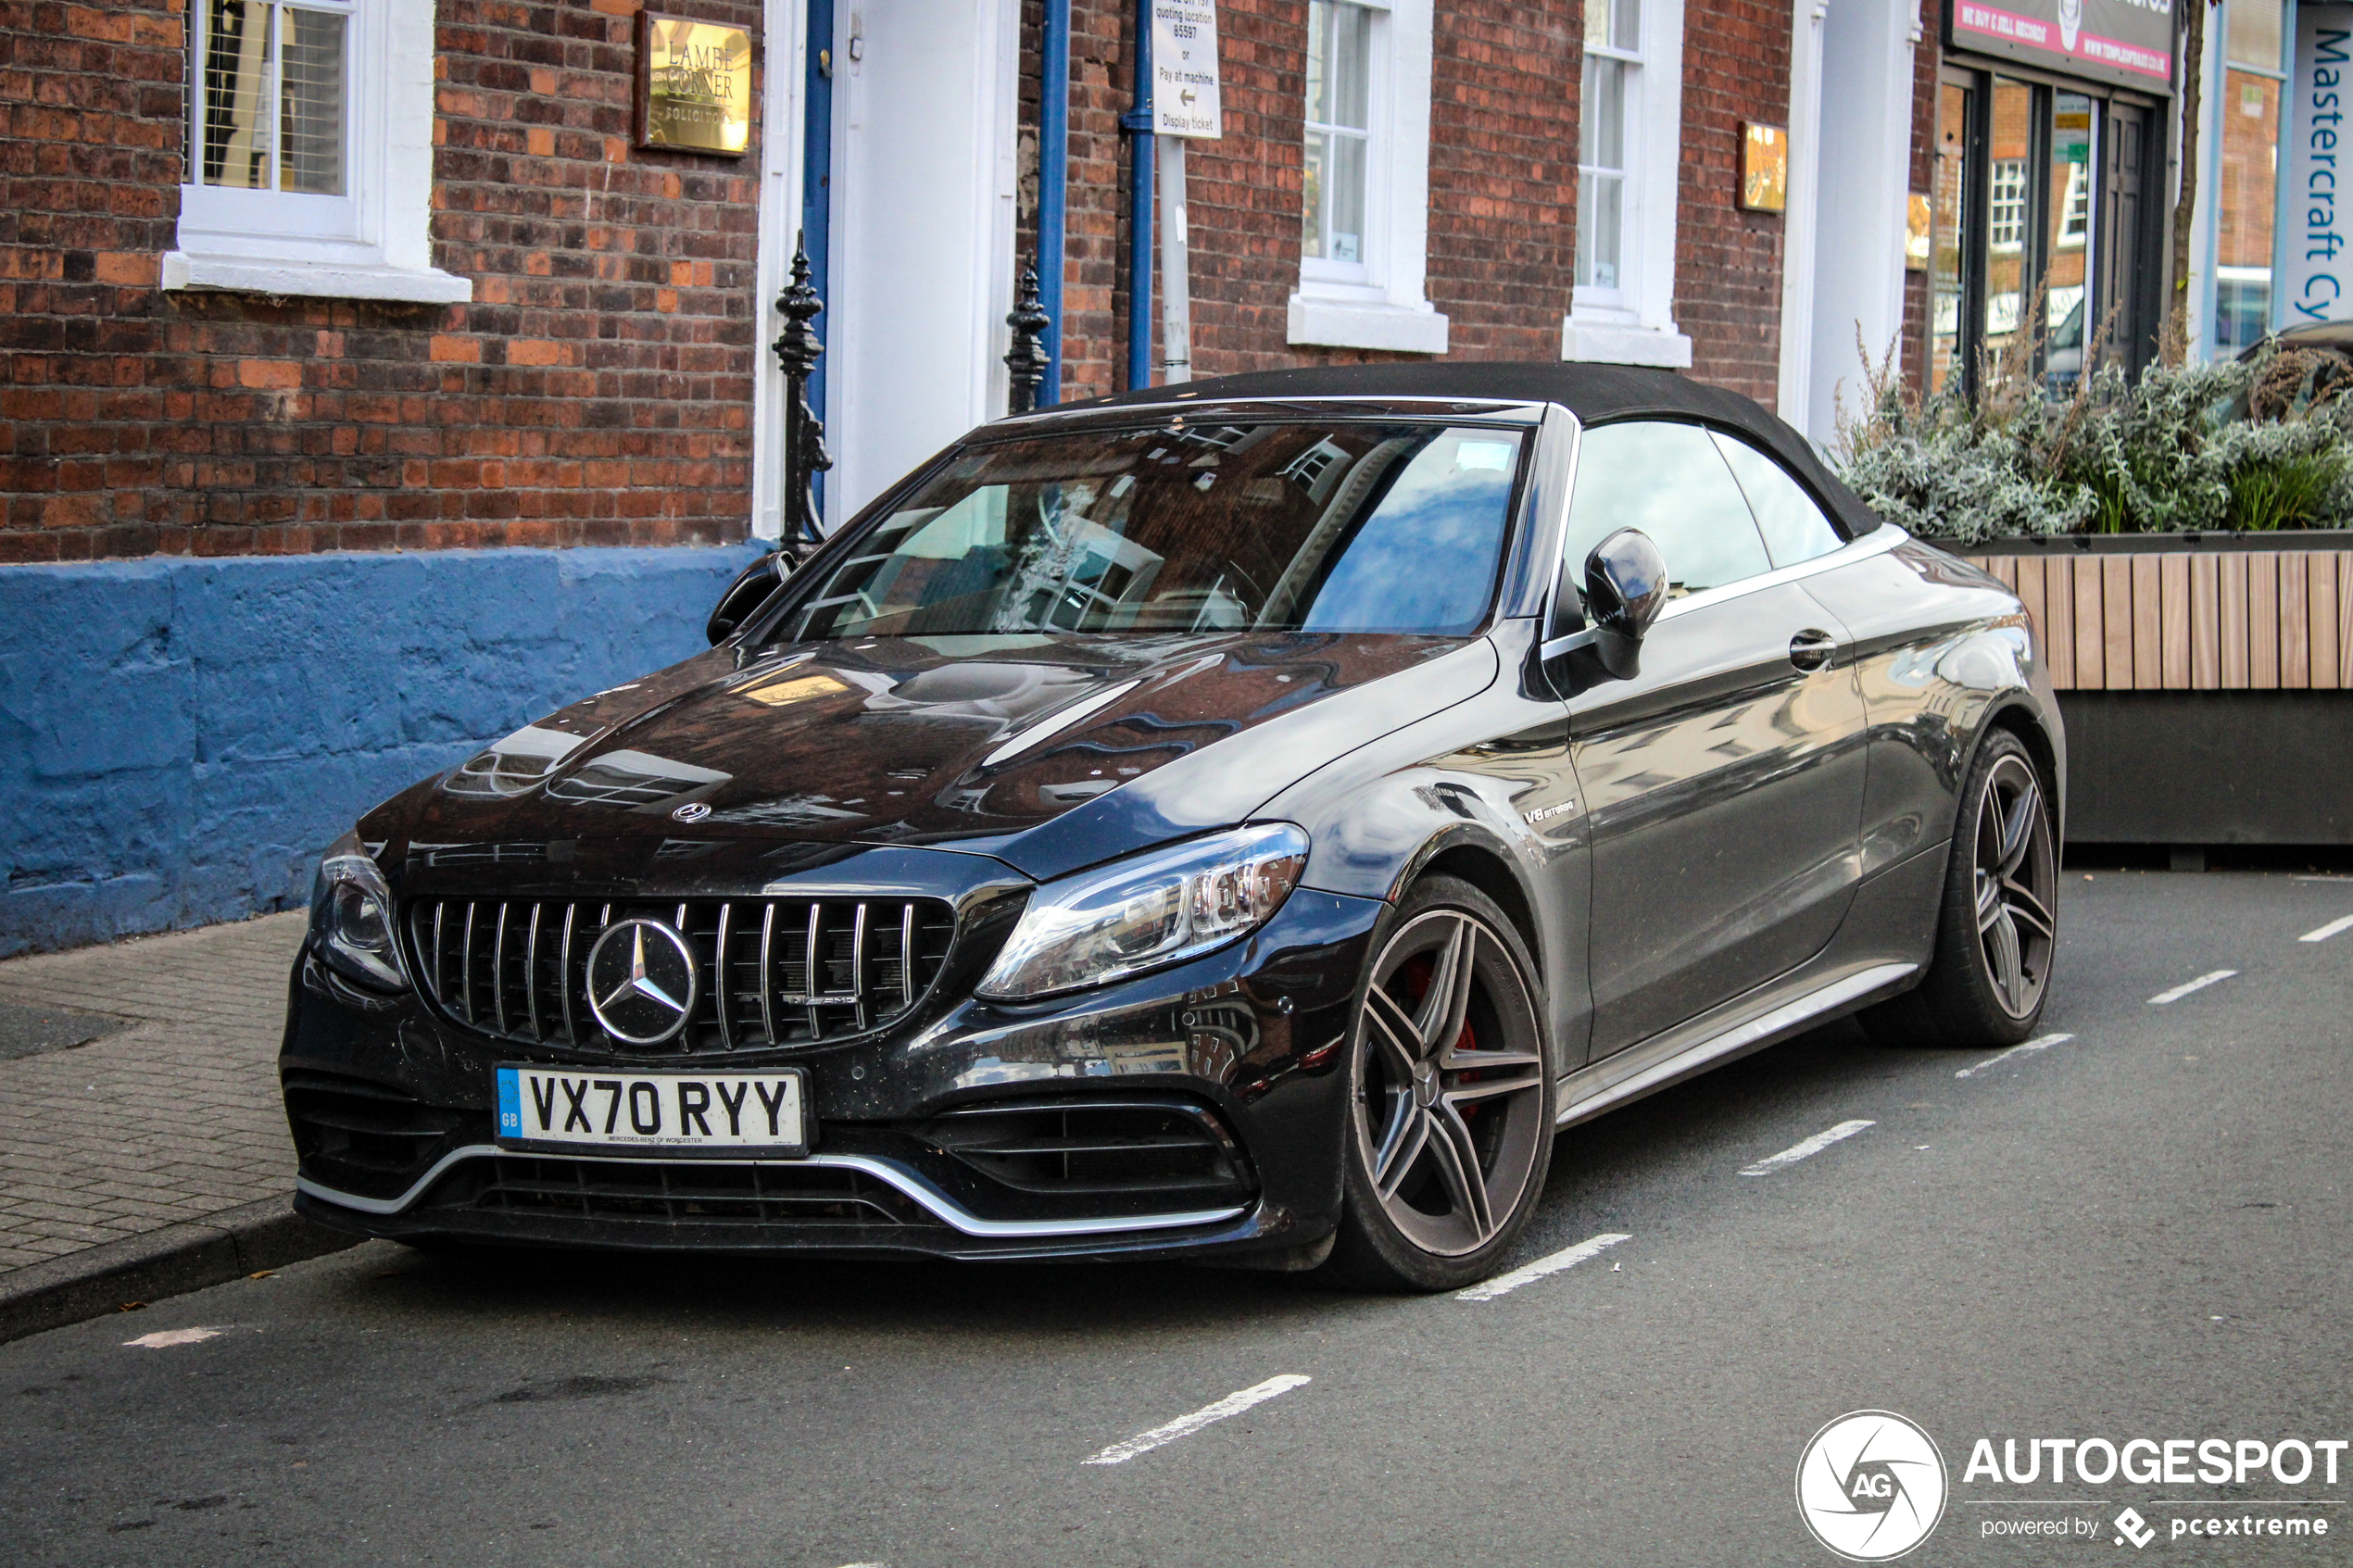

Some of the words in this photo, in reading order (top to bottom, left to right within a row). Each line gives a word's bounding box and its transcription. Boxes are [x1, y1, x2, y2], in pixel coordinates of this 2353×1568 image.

[1156, 6, 1183, 23] quoting
[1185, 8, 1213, 24] location
[1174, 24, 1196, 39] 85597
[669, 41, 733, 72] LAMBE
[1182, 50, 1189, 60] or
[666, 68, 734, 99] CORNER
[1159, 67, 1173, 83] Pay
[1175, 69, 1182, 82] at
[1184, 70, 1214, 85] machine
[665, 107, 733, 125] SOLICITORS
[1163, 113, 1189, 131] Display
[1191, 117, 1214, 131] ticket
[2305, 29, 2351, 261] Mastercraft
[1524, 808, 1544, 824] V8
[1544, 800, 1574, 819] BITURBO
[529, 1075, 662, 1135] VX70
[676, 1081, 787, 1137] RYY
[501, 1112, 519, 1128] GB
